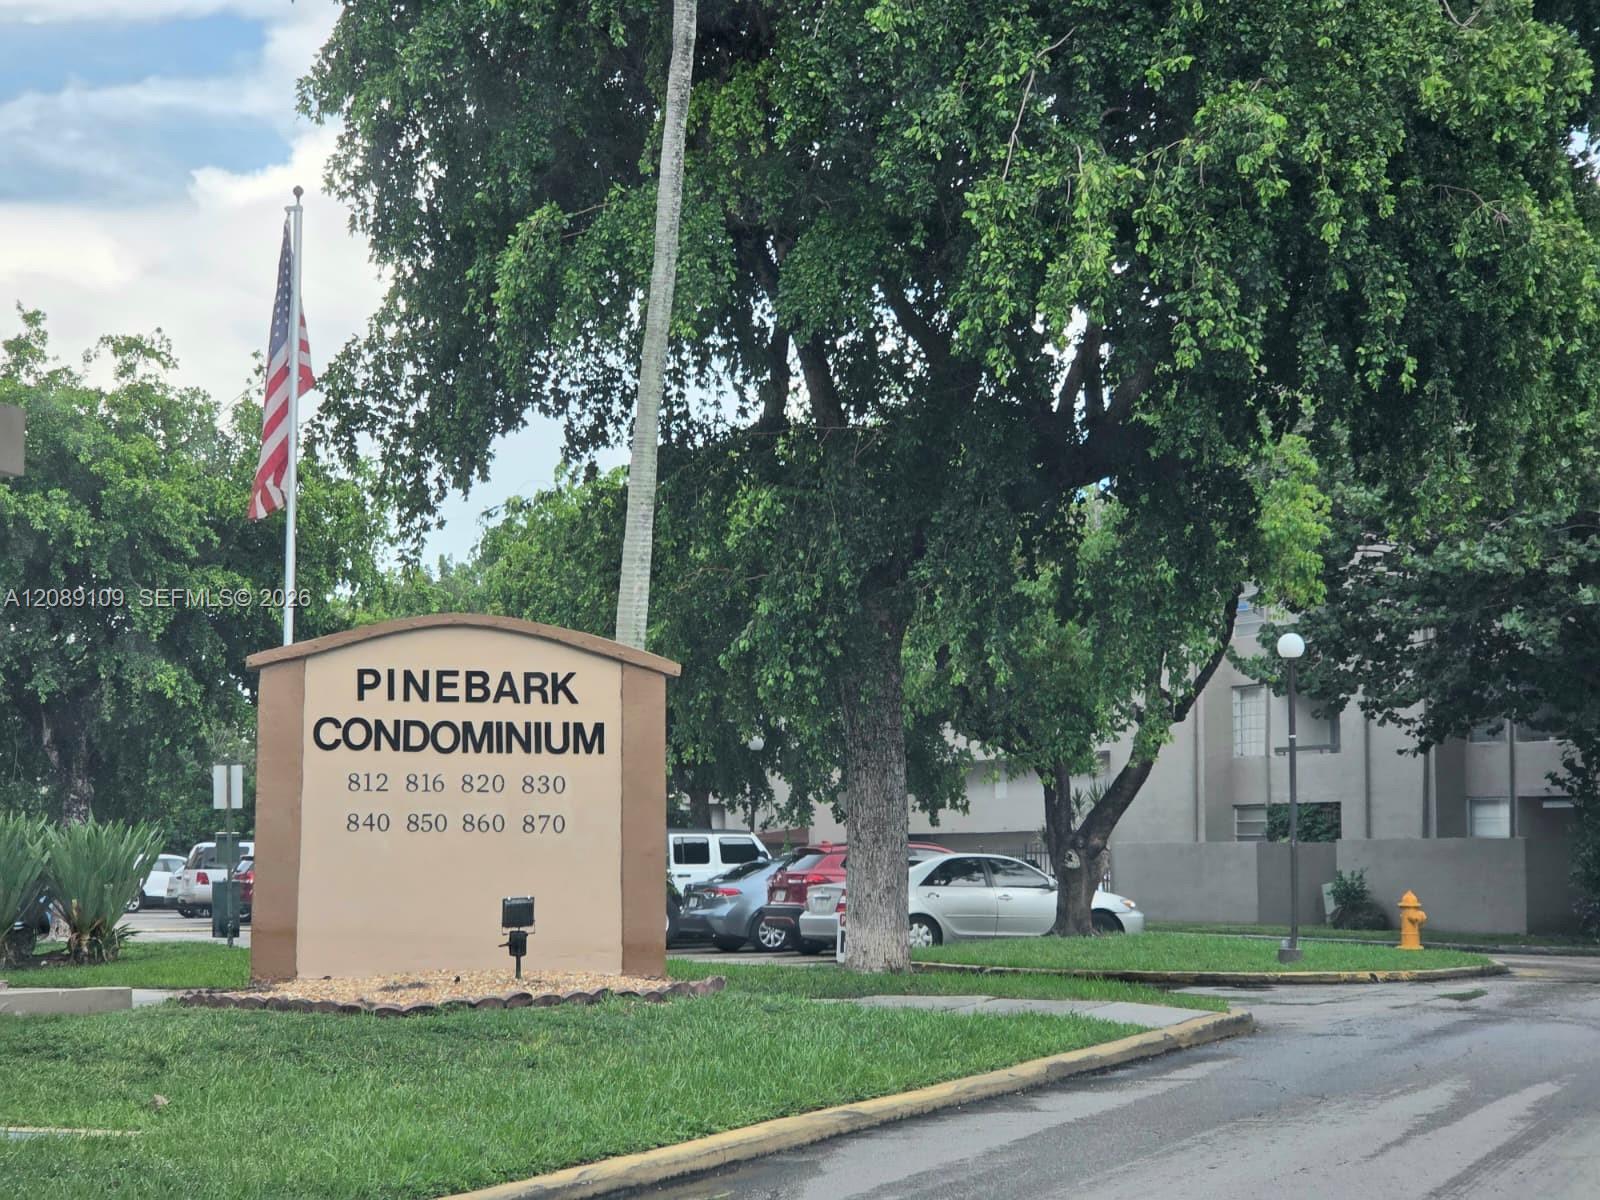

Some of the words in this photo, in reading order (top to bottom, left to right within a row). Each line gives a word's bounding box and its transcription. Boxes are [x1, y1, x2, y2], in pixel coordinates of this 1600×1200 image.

[357, 668, 579, 704] PINEBARK
[313, 717, 605, 755] CONDOMINIUM
[347, 773, 389, 793] 812
[405, 773, 445, 793] 816
[460, 774, 505, 793] 820
[521, 775, 566, 794] 830
[346, 813, 390, 832] 840
[406, 813, 448, 832] 850
[462, 814, 505, 833] 860
[522, 815, 566, 833] 870
